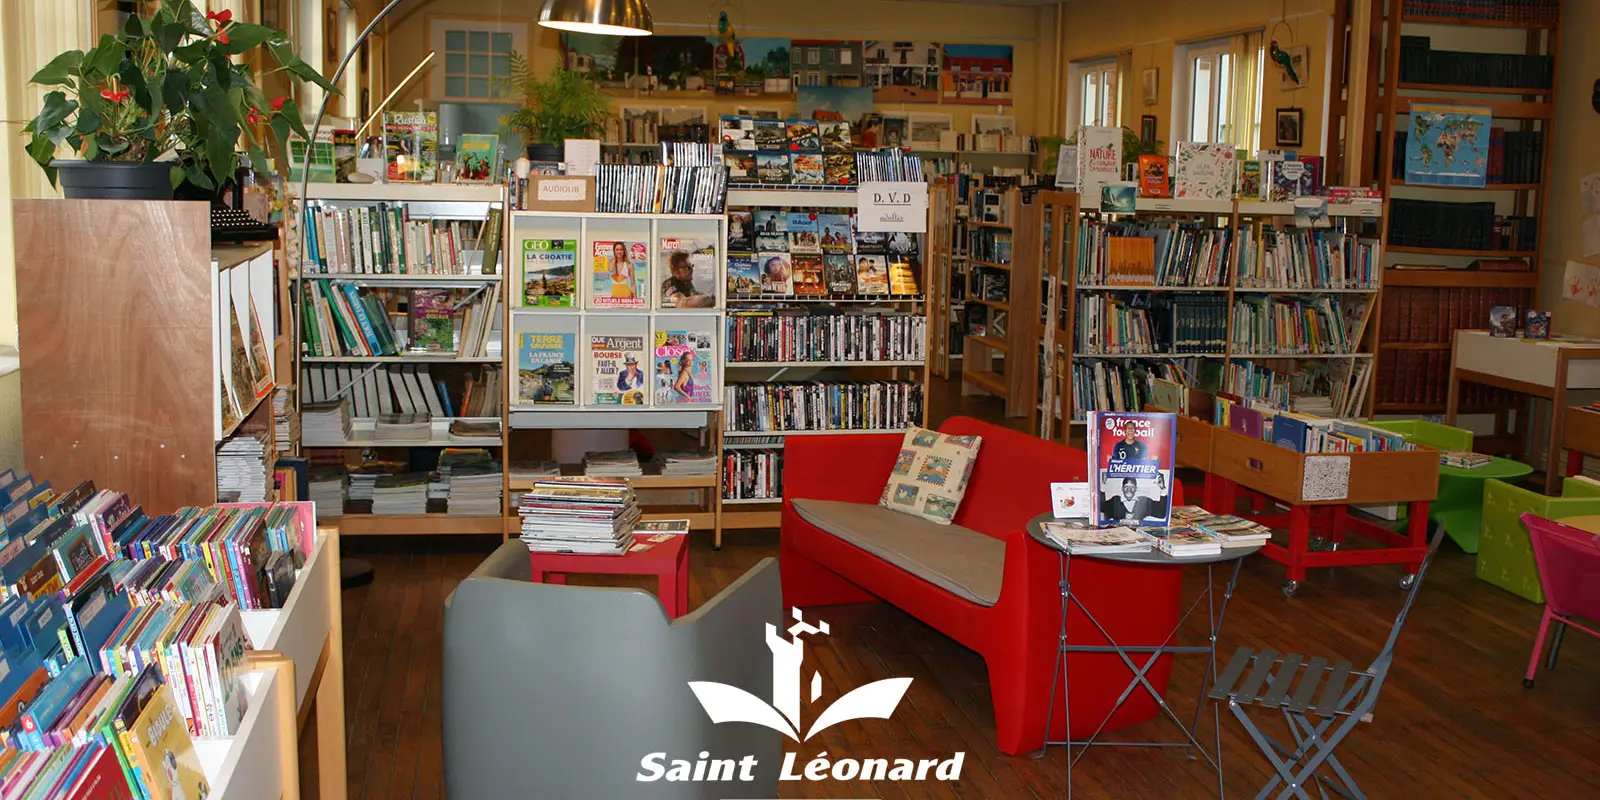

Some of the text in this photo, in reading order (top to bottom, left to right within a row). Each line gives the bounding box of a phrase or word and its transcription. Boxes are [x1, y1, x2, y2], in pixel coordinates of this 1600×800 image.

[1089, 148, 1116, 160] NATURE
[543, 185, 580, 193] AUDIOLIB
[524, 240, 549, 250] GEO
[607, 338, 642, 350] Argent
[1112, 426, 1154, 437] foball
[1109, 462, 1156, 473] L'HÉRITIER
[26, 719, 34, 730] 6
